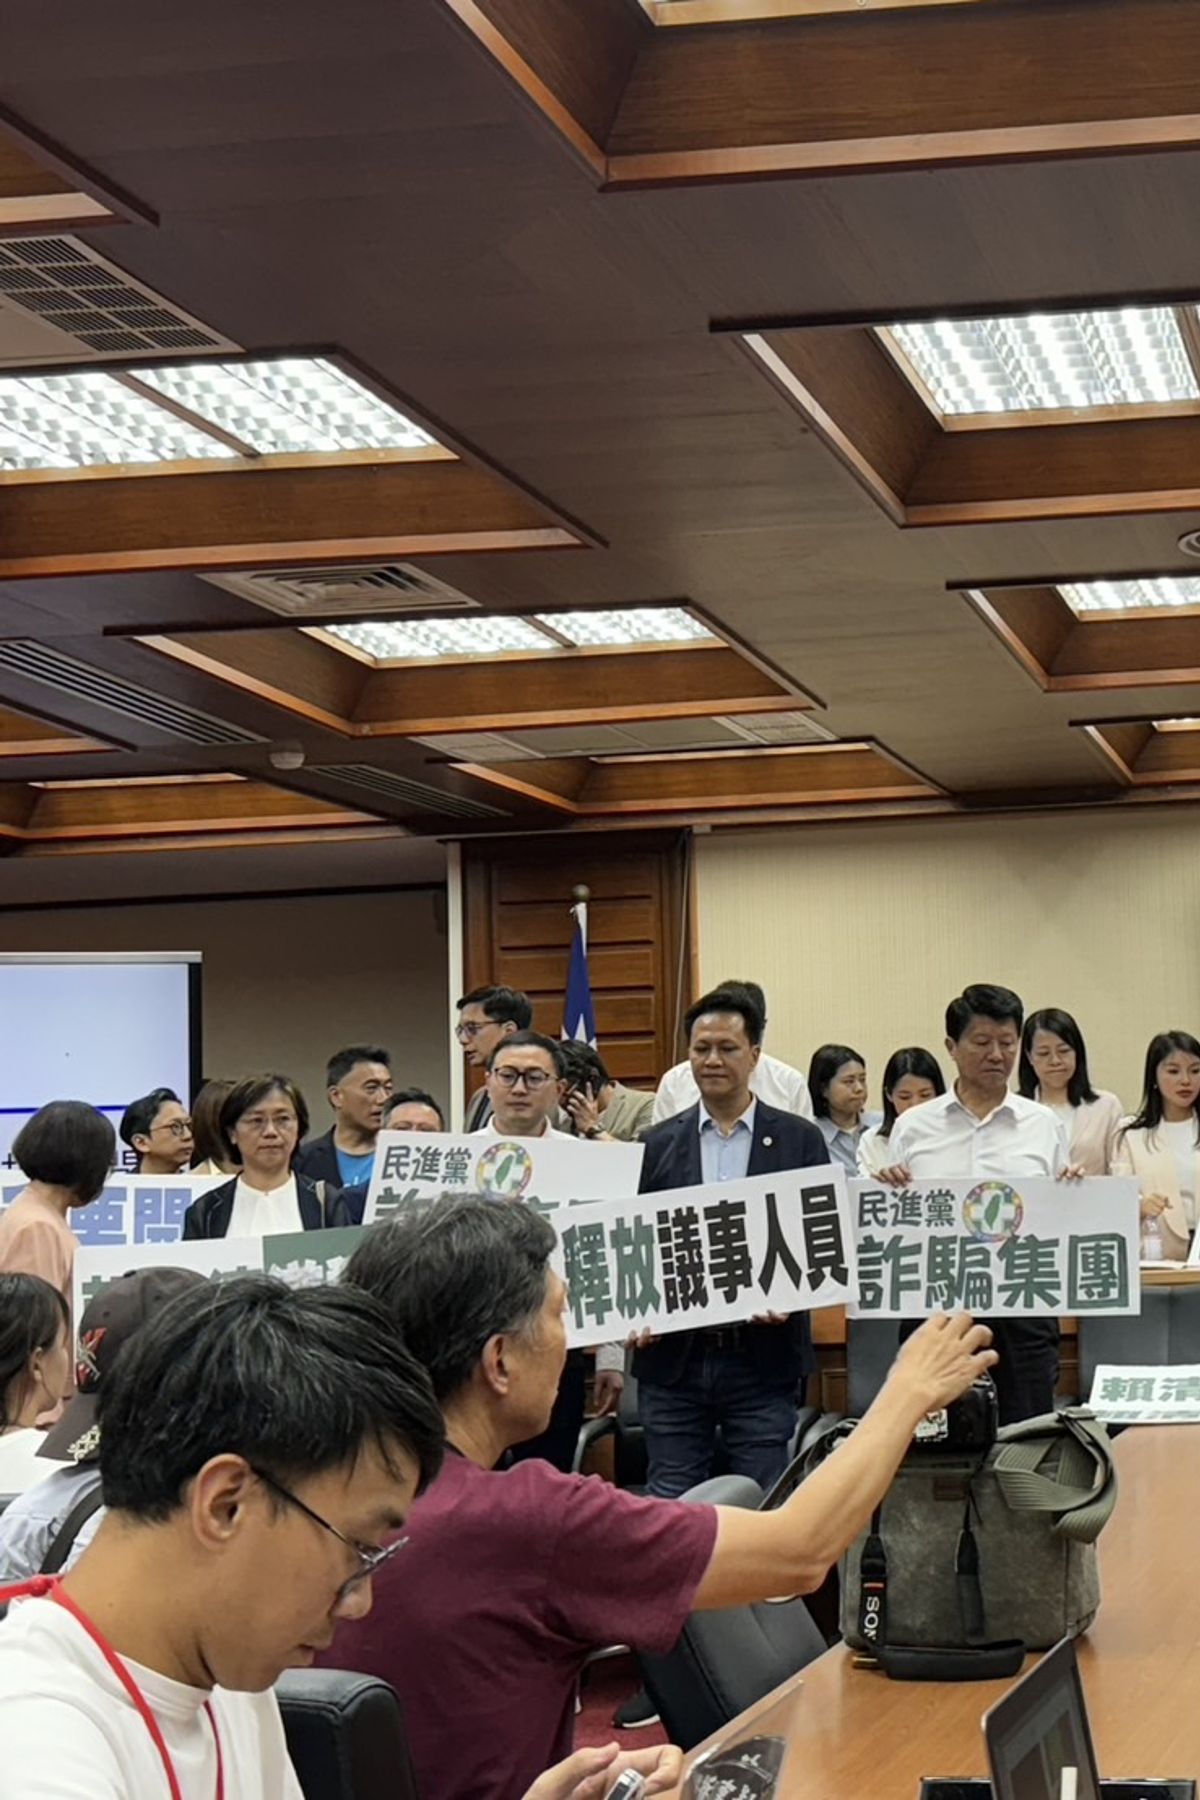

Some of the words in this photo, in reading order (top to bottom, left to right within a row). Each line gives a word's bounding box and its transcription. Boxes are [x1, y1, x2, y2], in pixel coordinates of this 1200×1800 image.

[381, 1144, 472, 1185] 民進黨
[857, 1188, 957, 1229] 民進黨
[561, 1182, 849, 1330] 釋放議事人員
[855, 1231, 1129, 1313] 詐騙集團
